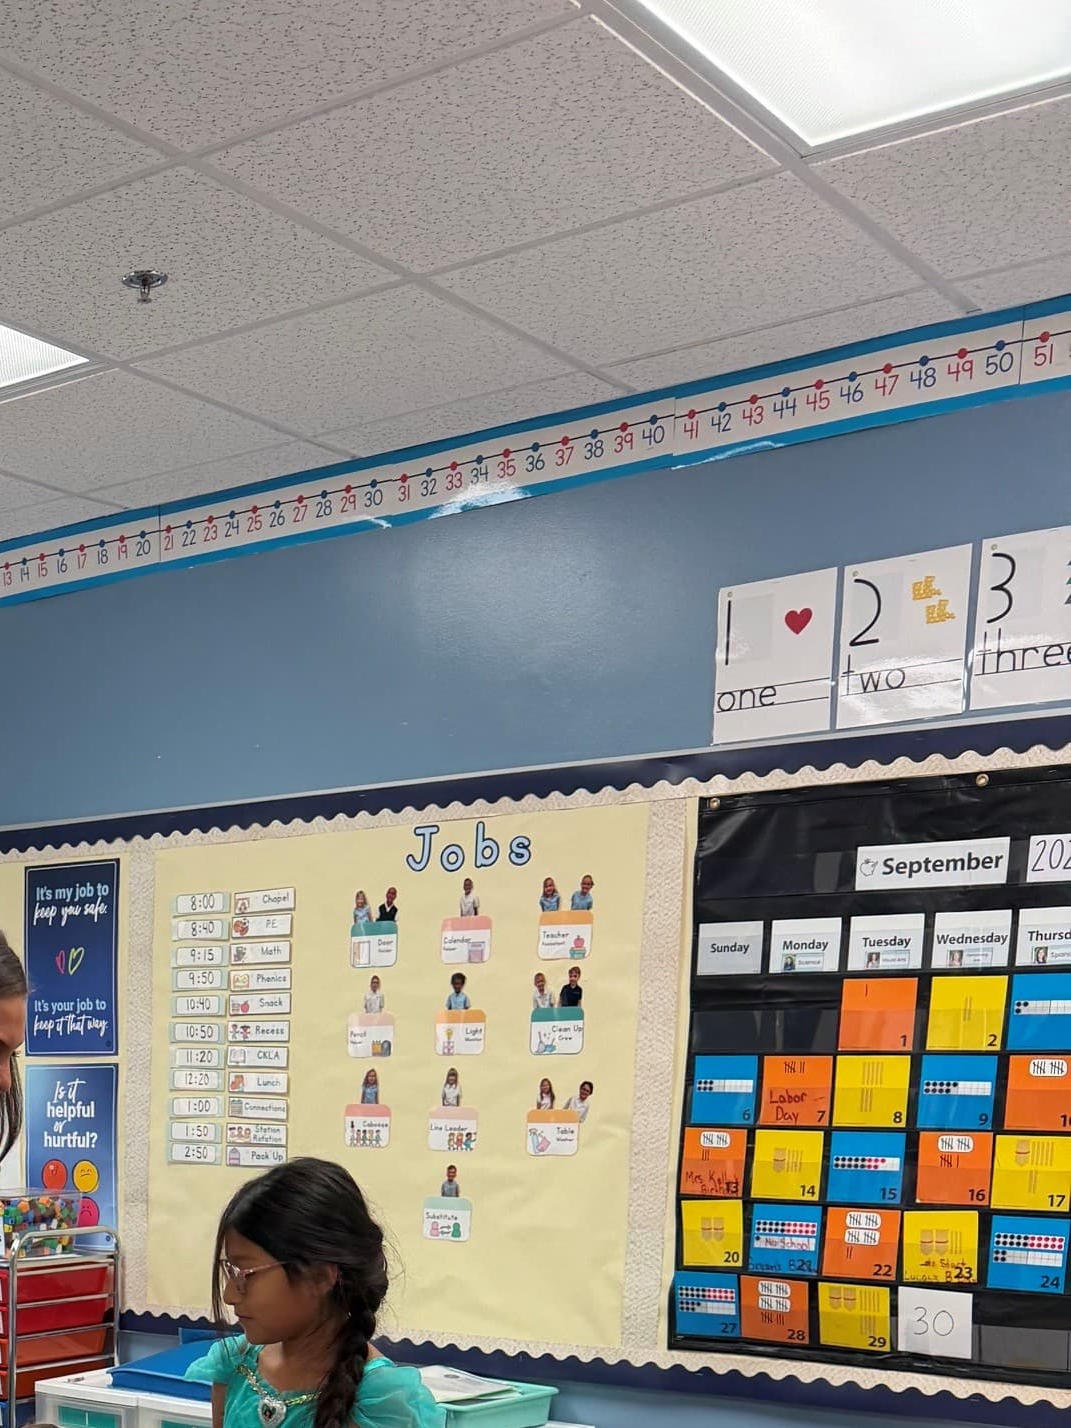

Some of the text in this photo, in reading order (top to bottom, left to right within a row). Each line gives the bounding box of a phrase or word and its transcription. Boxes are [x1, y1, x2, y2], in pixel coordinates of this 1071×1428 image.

[98, 344, 1054, 565] 18 19 20 21 22 23 24 25 26 27 28 29 30 31 32 33 34 35 36 37 38 39 40 41 42 43 44 45 46 47 48 49 50 51
[986, 552, 1016, 624] 3
[849, 578, 881, 646] 2
[976, 628, 1071, 675] thre
[842, 654, 905, 696] two
[717, 685, 777, 712] one
[406, 821, 532, 872] Jobs
[882, 852, 1004, 878] September
[36, 882, 109, 902] It's my job to
[190, 895, 214, 910] 8:00
[34, 902, 58, 926] keep
[61, 904, 82, 926] you
[191, 922, 214, 936] 8:40
[782, 938, 829, 952] Monday
[862, 935, 912, 950] Tuesday
[936, 932, 1008, 946] Wednesday
[710, 942, 750, 954] Sunday
[190, 949, 214, 962] 9:15
[189, 972, 214, 986] 9:50
[35, 998, 106, 1014] It's your job to
[186, 998, 211, 1010] 10:40
[34, 1015, 54, 1038] keep
[186, 1026, 214, 1039] 10:50
[255, 1026, 284, 1036] Recess
[900, 1034, 908, 1046] 1
[988, 1034, 997, 1046] 2
[186, 1051, 213, 1064] 11:20
[184, 1073, 210, 1086] 12:20
[53, 1078, 86, 1103] Is it
[770, 1091, 808, 1104] Labor
[47, 1101, 95, 1122] helpful
[188, 1100, 211, 1112] 1:00
[742, 1108, 751, 1121] 6
[776, 1106, 799, 1123] Day
[816, 1110, 825, 1122] 7
[893, 1111, 902, 1124] 8
[979, 1113, 988, 1126] 9
[54, 1119, 68, 1134] or
[186, 1126, 208, 1138] 1:50
[44, 1132, 98, 1148] hurtful?
[184, 1147, 208, 1160] 2:50
[725, 1181, 738, 1194] 13
[800, 1185, 816, 1197] 14
[880, 1187, 897, 1200] 15
[968, 1188, 986, 1202] 16
[1048, 1194, 1066, 1208] 17
[724, 1251, 740, 1264] 20
[873, 1264, 892, 1277] 22
[954, 1266, 972, 1280] 23
[1041, 1276, 1060, 1288] 24
[720, 1322, 737, 1334] 27
[914, 1306, 954, 1336] 30
[788, 1329, 806, 1341] 28
[868, 1336, 887, 1348] 29
